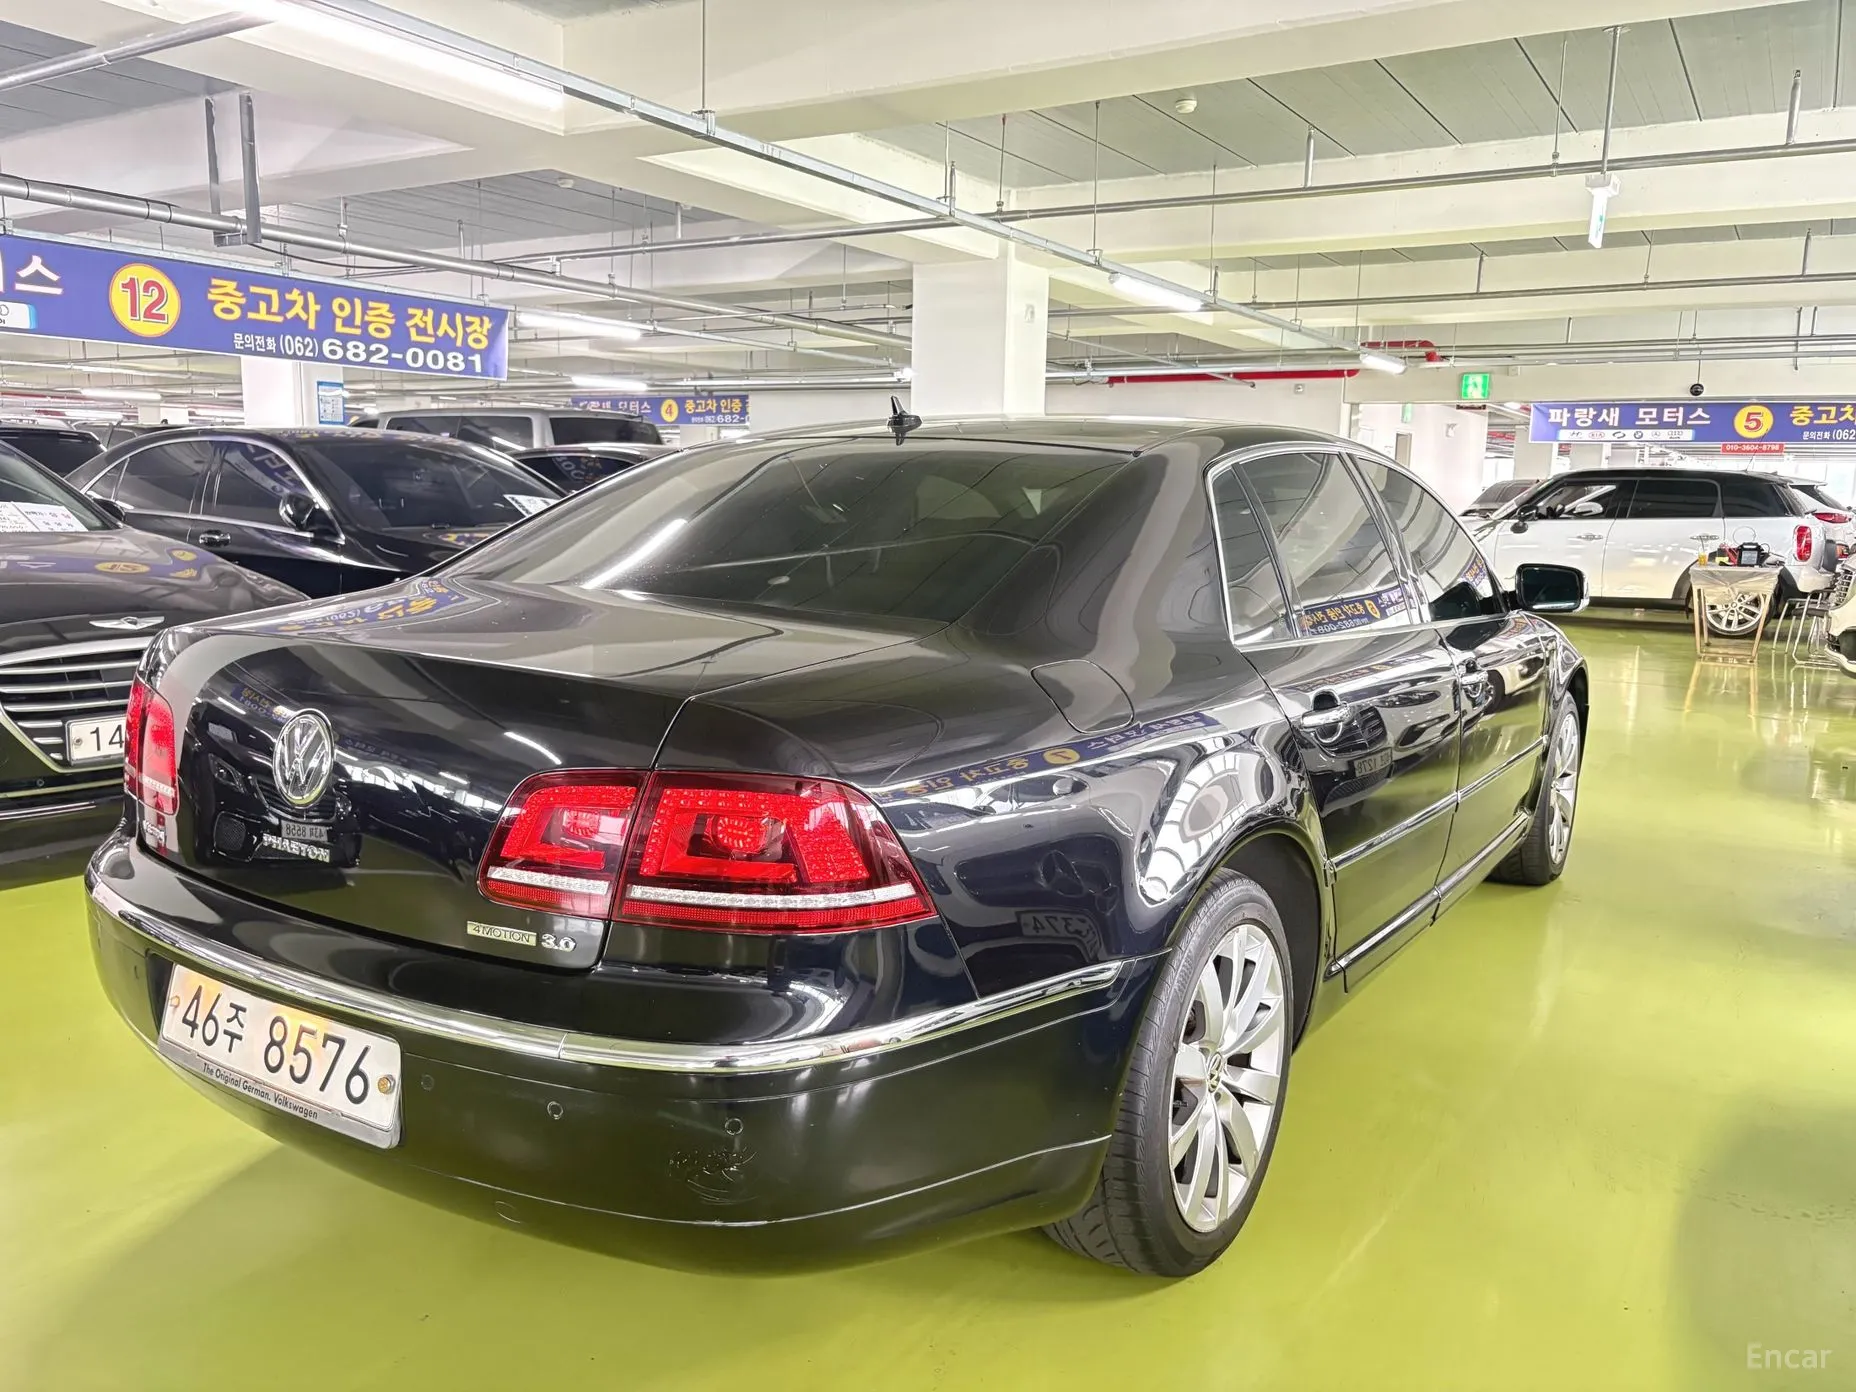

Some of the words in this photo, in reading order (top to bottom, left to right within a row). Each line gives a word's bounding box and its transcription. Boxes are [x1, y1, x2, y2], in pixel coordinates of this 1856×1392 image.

[0, 250, 64, 295] 스
[120, 276, 168, 324] 12
[207, 277, 321, 330] 중고차
[331, 296, 396, 339] 인증
[405, 307, 493, 350] 전시장
[233, 332, 277, 353] 문의전화
[279, 334, 319, 357] (062)
[322, 338, 482, 373] 682-0081
[664, 404, 674, 418] 4
[684, 398, 718, 414] 중고차
[720, 398, 743, 414] 인증
[1548, 406, 1620, 427] 파랑새
[1635, 406, 1712, 426] 모터스
[1743, 411, 1764, 432] 5
[263, 833, 330, 863] PHAETON
[472, 924, 530, 943] 4MOTION
[541, 933, 577, 953] 3.0
[181, 984, 247, 1053] 46주
[263, 1014, 372, 1105] 8576
[203, 1062, 215, 1076] The
[215, 1068, 241, 1088] Original
[273, 1092, 318, 1119] Volkswagen
